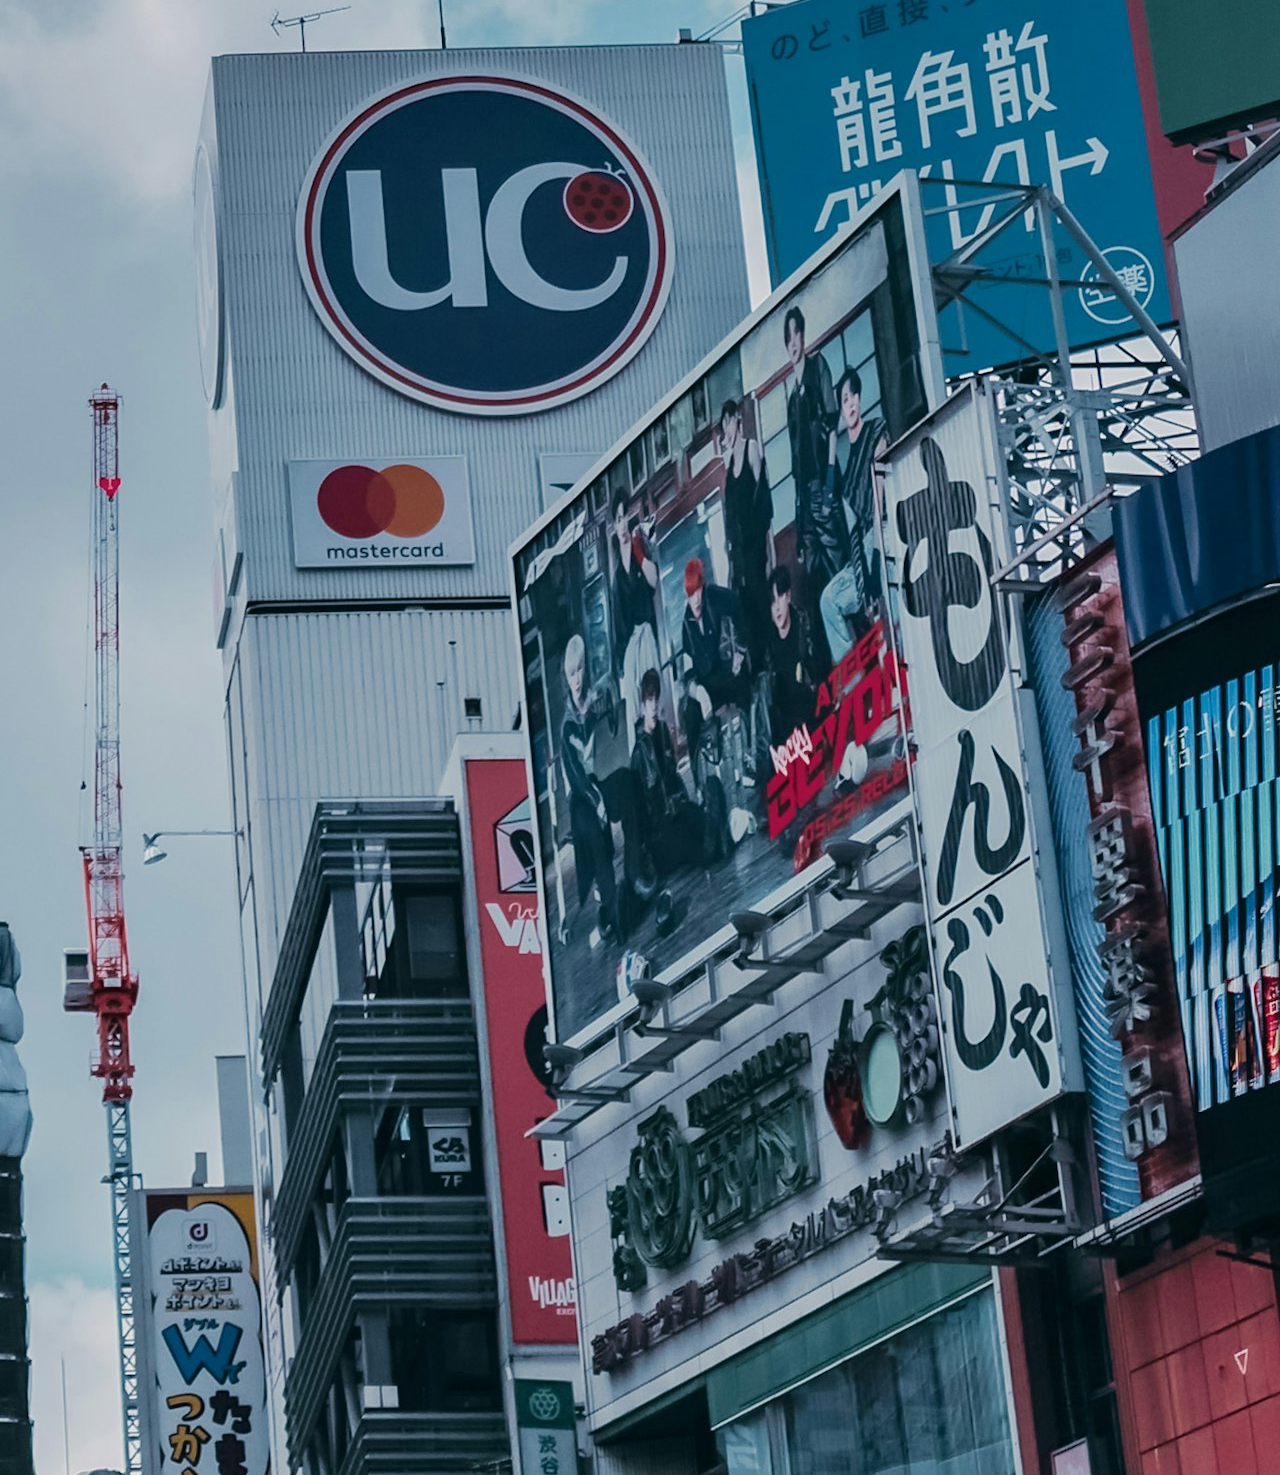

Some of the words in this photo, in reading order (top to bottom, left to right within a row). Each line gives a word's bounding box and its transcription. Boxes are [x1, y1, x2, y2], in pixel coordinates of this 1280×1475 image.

[830, 20, 1060, 174] 龍角散
[326, 542, 444, 560] mastercard
[895, 436, 1061, 1090] もんじゃ
